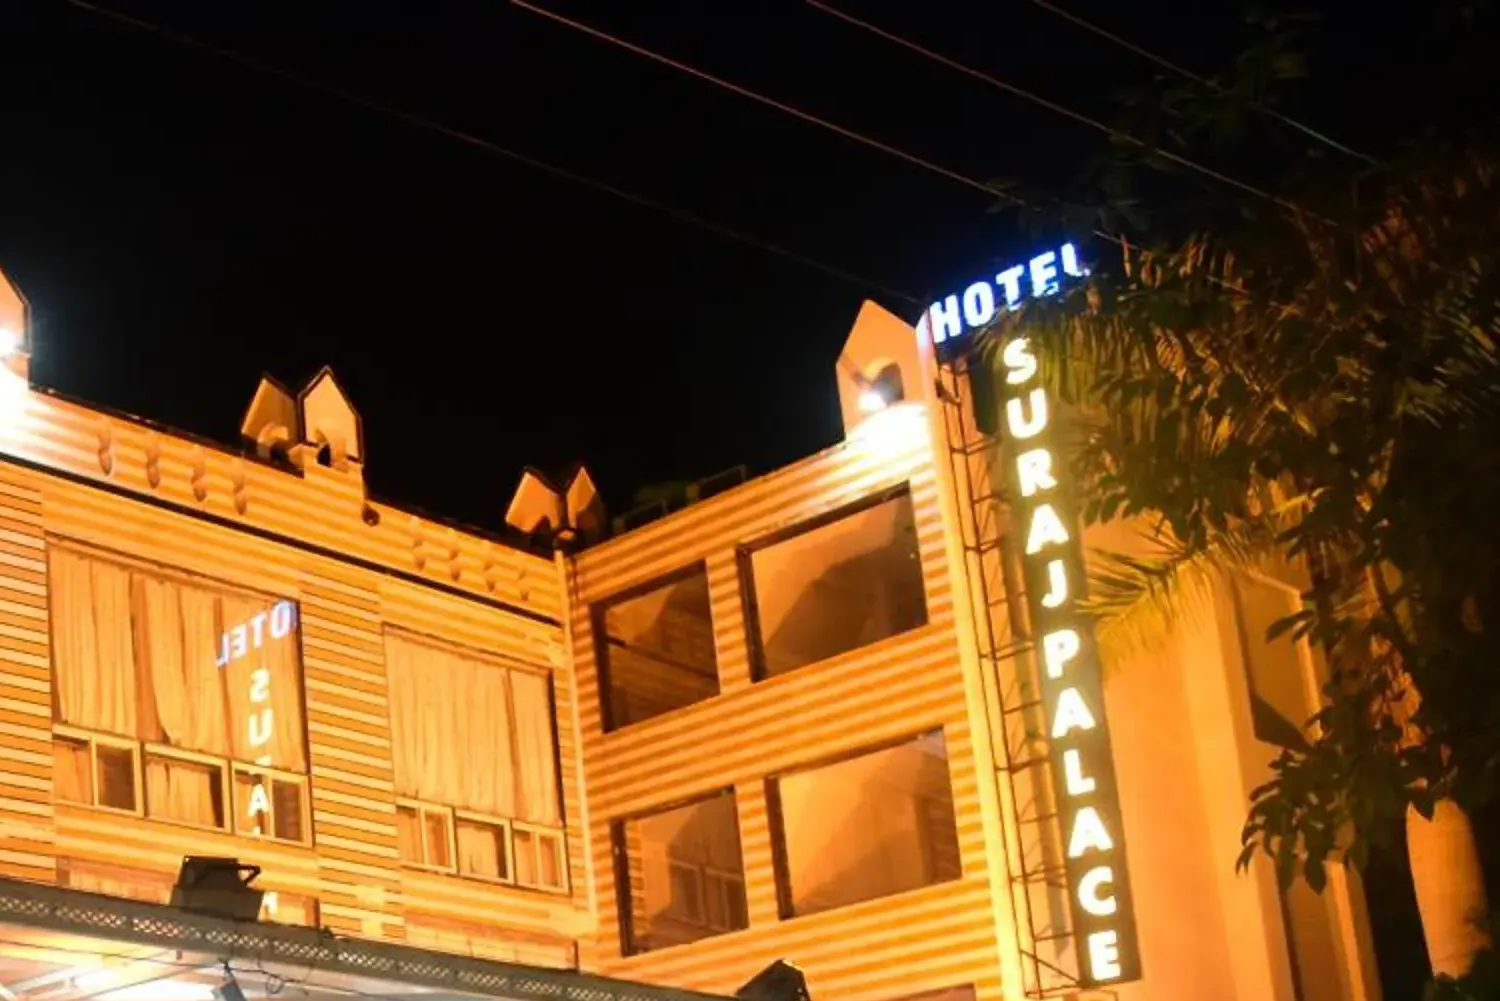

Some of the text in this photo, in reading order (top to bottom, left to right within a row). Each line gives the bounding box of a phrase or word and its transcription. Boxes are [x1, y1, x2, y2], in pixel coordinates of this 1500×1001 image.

[929, 243, 1091, 343] HOTEL
[1003, 337, 1121, 981] SURAJ PALACE
